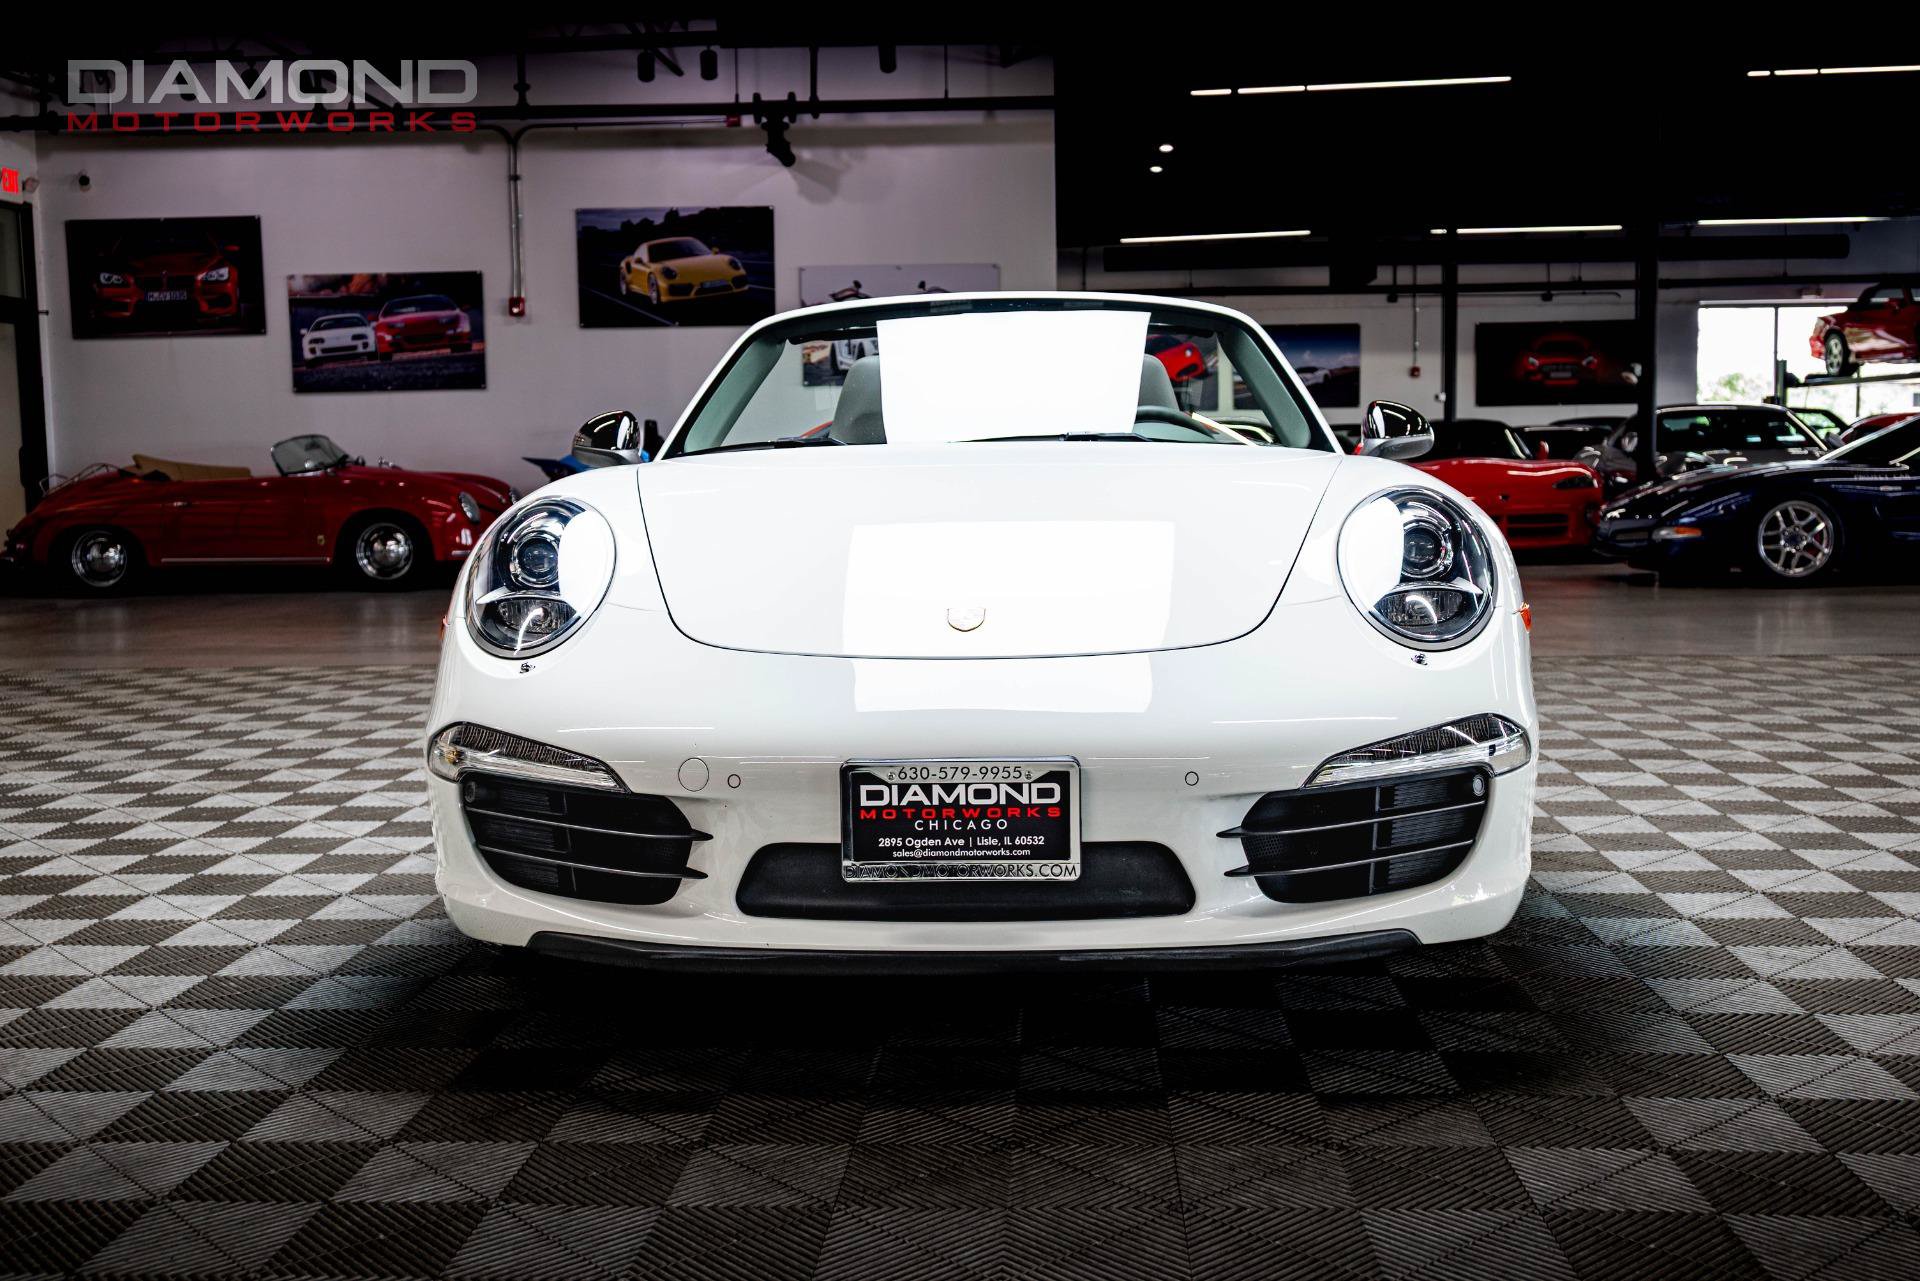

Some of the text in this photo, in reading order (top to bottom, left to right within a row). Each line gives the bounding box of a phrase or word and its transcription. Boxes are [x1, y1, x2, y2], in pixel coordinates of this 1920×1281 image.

[897, 766, 1023, 780] 630-579-9955
[859, 782, 1061, 807] DIAMOND
[859, 807, 1062, 820] MOTORWORKS
[914, 819, 1008, 831] CHICAGO
[878, 837, 903, 847] 2895
[905, 837, 942, 848] Ogden
[944, 837, 965, 846] Ave
[976, 836, 1001, 846] Lisle,
[1004, 836, 1012, 845] IL
[1014, 835, 1045, 845] 60532
[892, 848, 1031, 858] sales@diamondmotorworks.com
